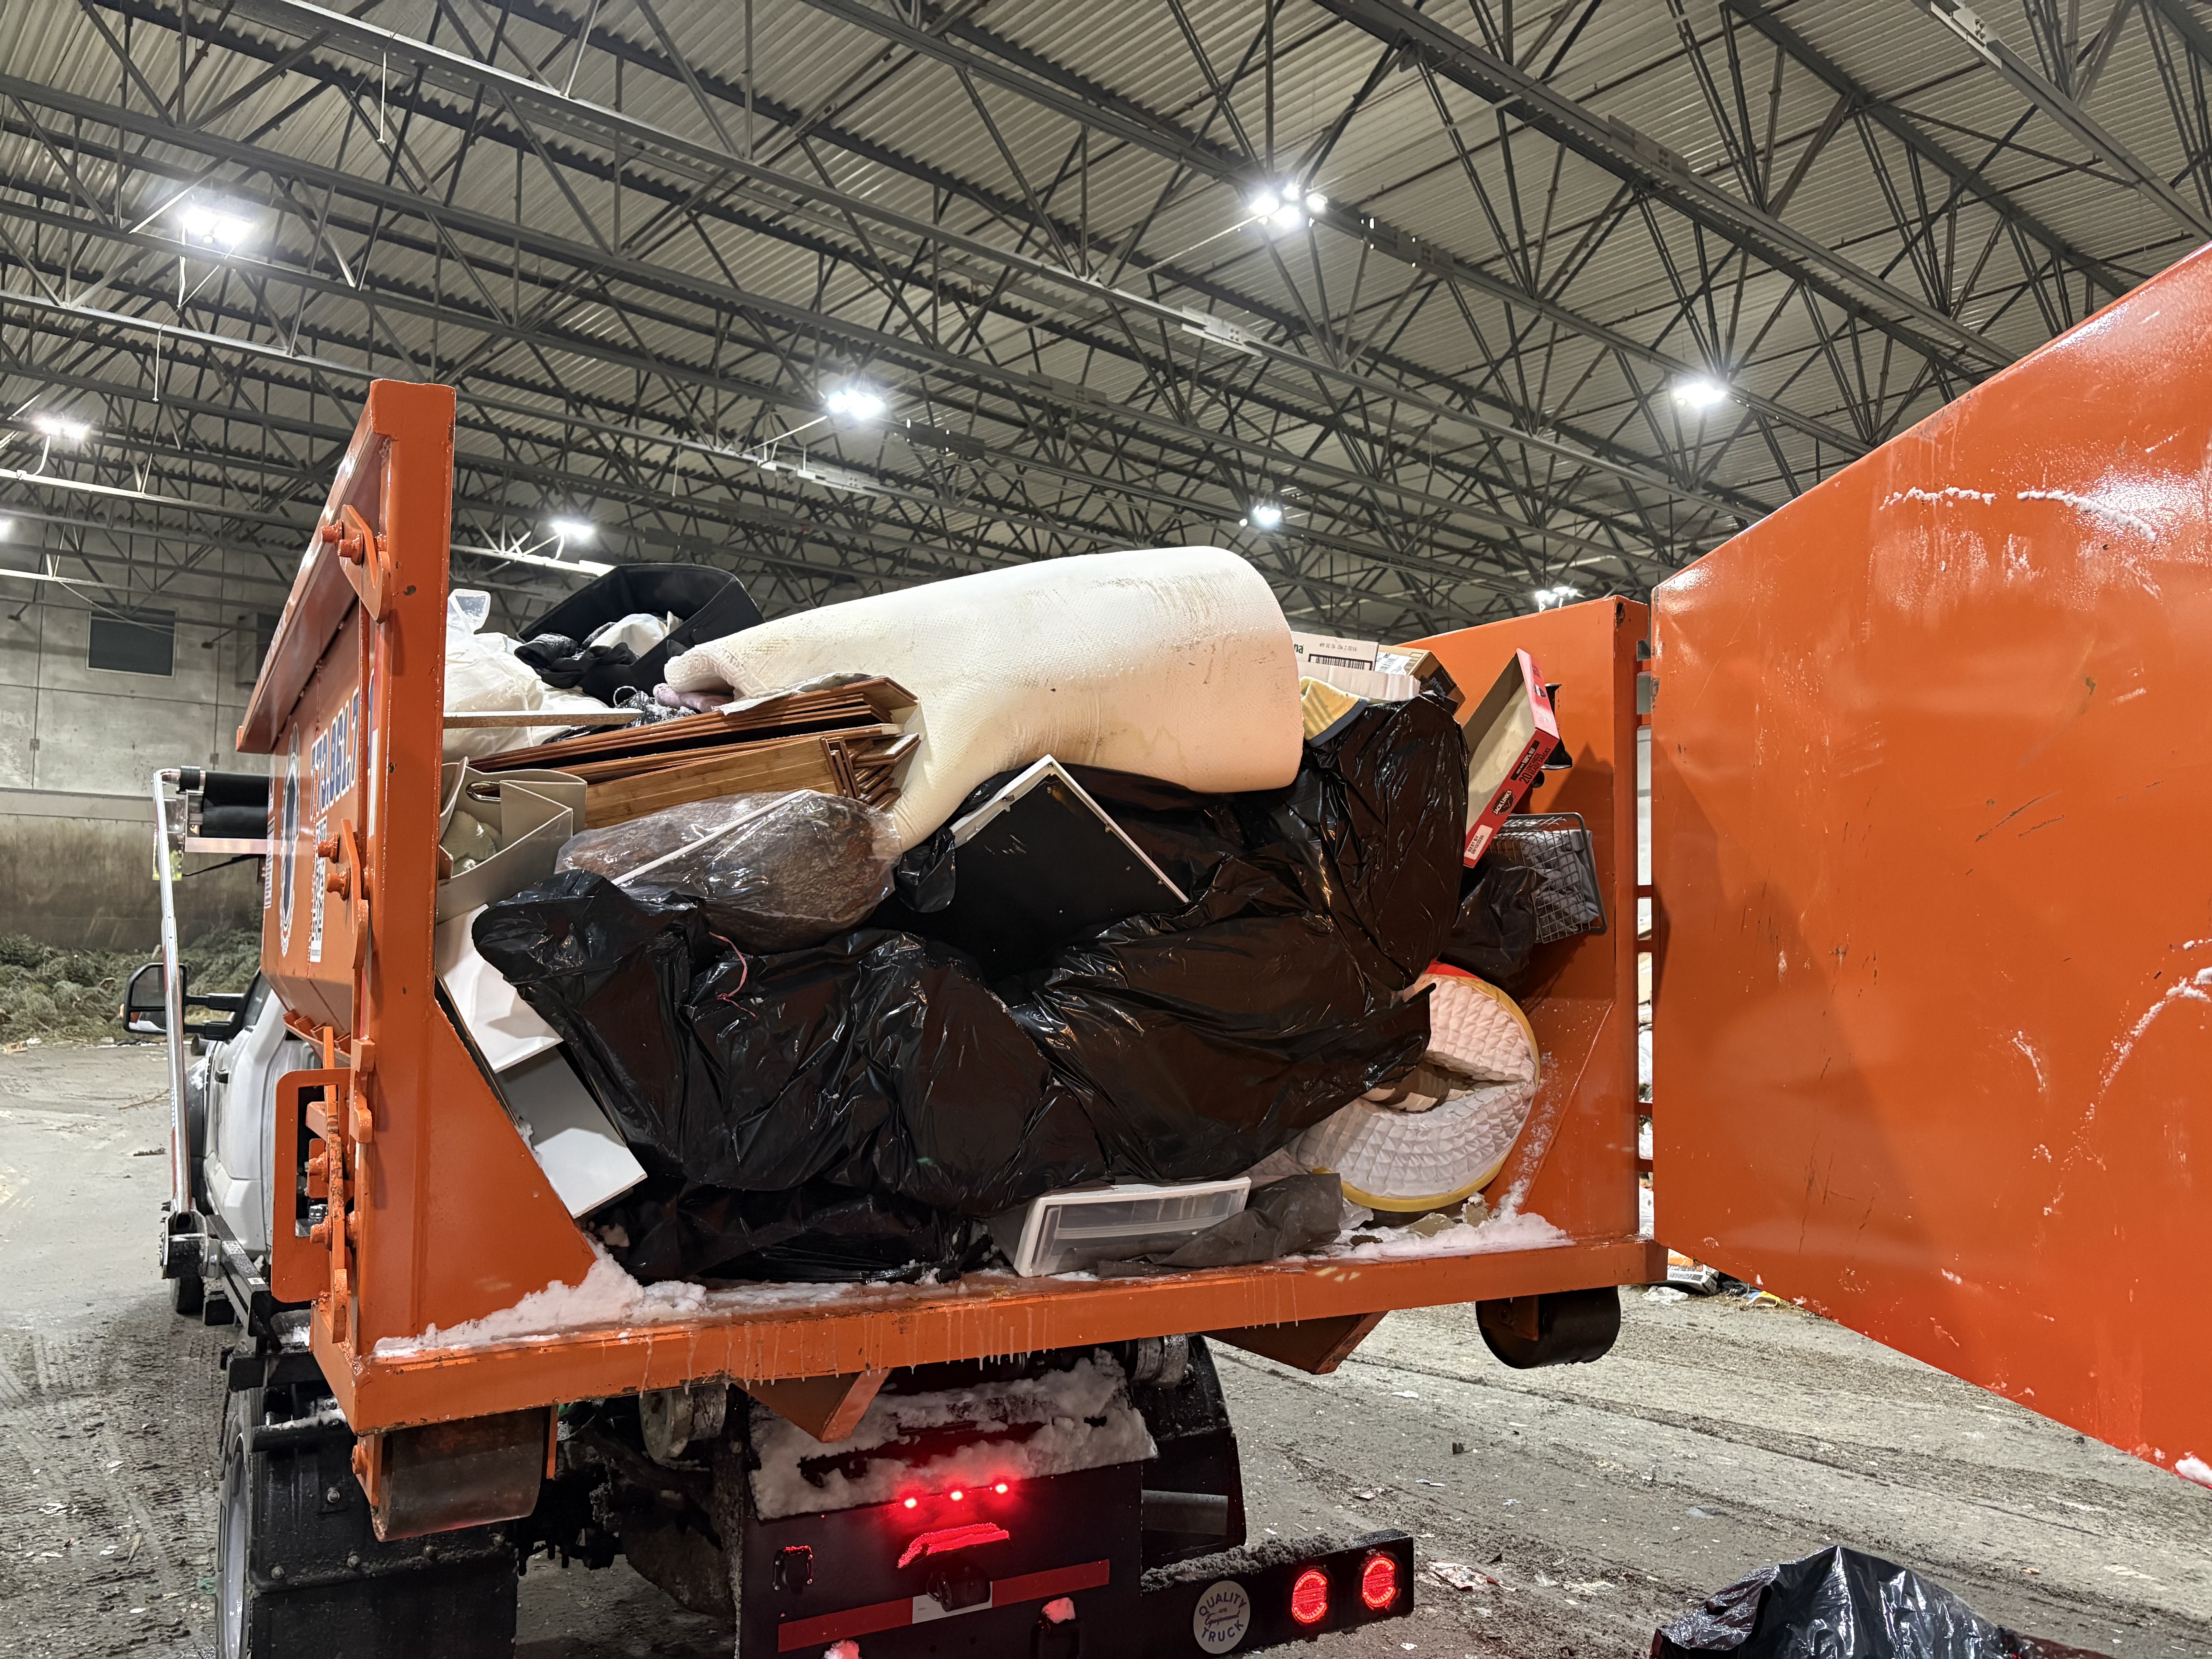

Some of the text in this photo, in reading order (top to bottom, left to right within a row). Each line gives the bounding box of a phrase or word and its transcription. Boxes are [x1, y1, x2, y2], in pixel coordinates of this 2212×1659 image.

[1294, 644, 1304, 654] na
[1431, 677, 1446, 696] prime
[310, 676, 373, 821] 773.861.7
[1538, 747, 1551, 763] SNACKS
[1519, 771, 1532, 784] 20
[1493, 802, 1504, 815] JACK
[1467, 842, 1475, 852] BEST
[1199, 1592, 1247, 1616] QUALITY
[1202, 1619, 1244, 1642] TRUCK
